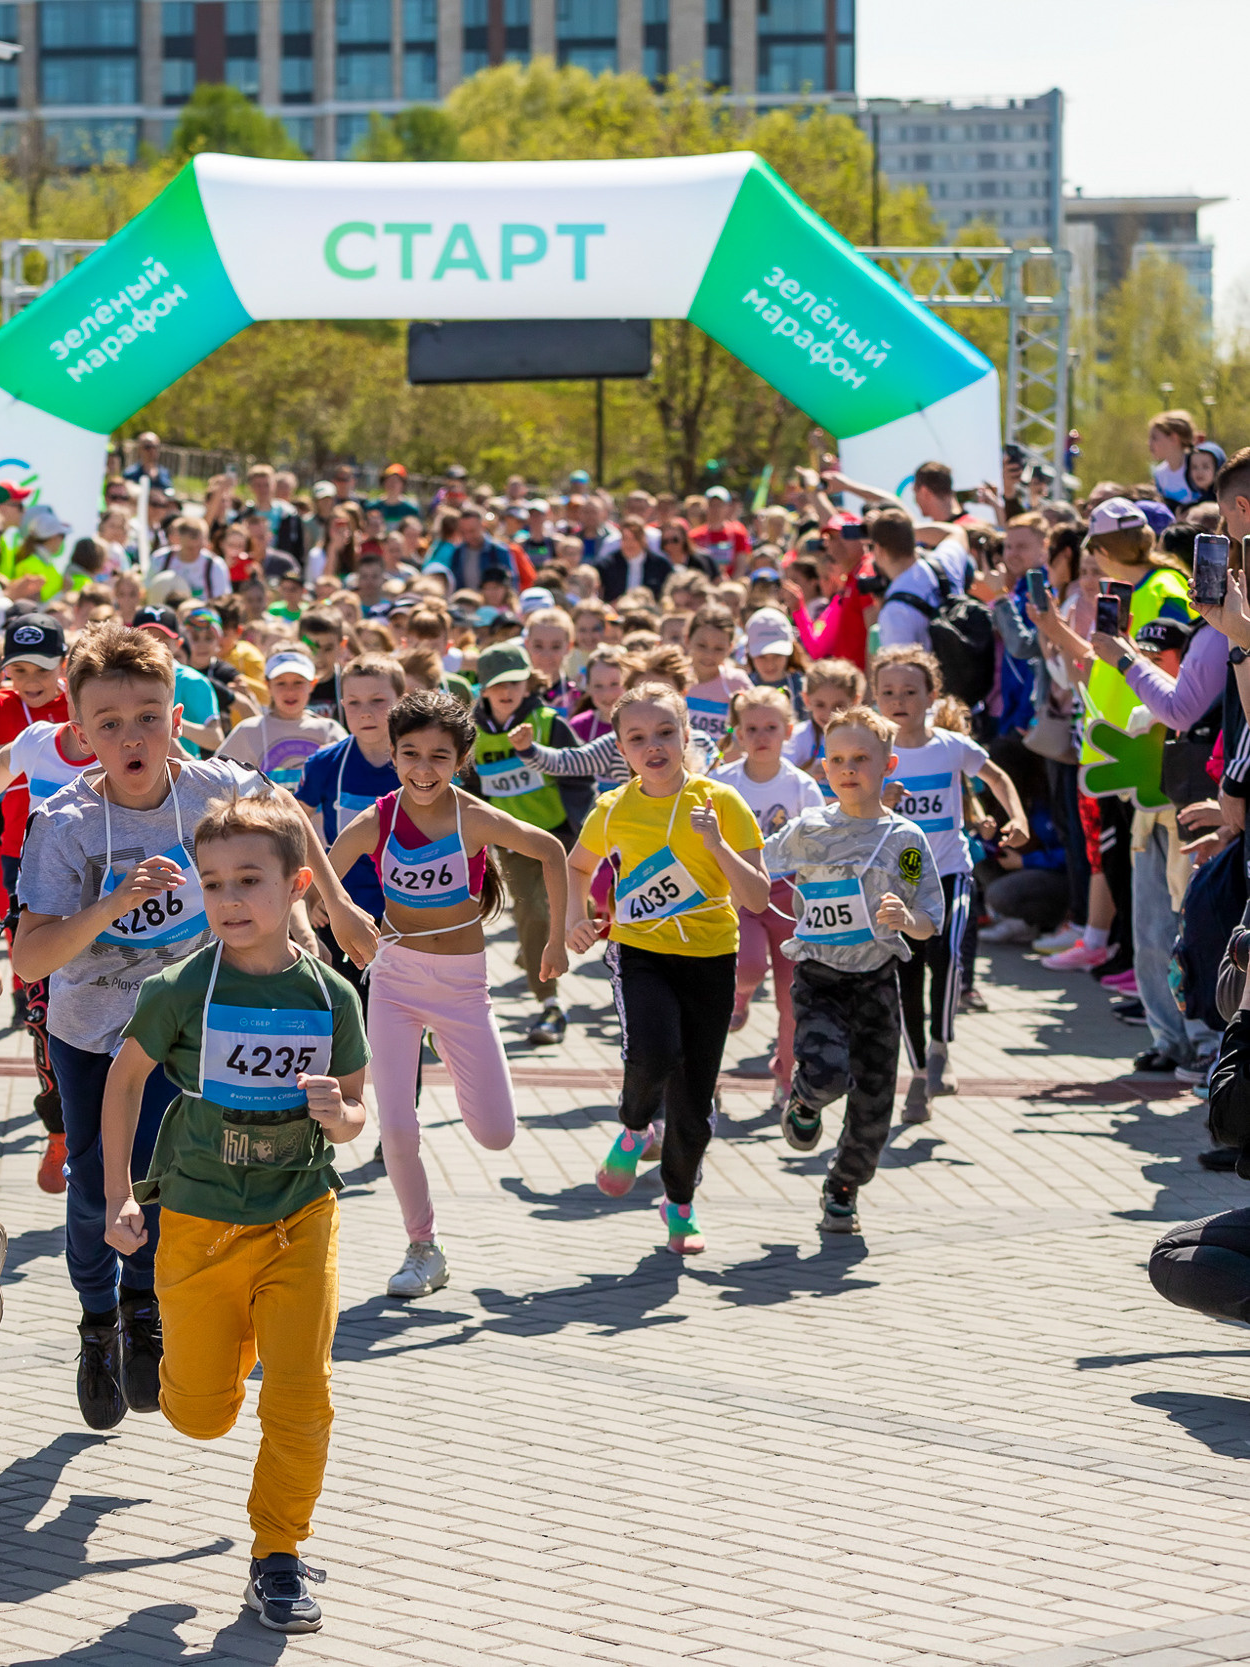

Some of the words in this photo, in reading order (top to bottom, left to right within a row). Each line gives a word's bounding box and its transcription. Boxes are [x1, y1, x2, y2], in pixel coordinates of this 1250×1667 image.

[323, 222, 606, 280] СТАРТ
[50, 257, 169, 360] зелёный
[66, 284, 188, 382] марафон
[764, 267, 892, 368] зелёный
[742, 289, 867, 389] марафон
[390, 863, 453, 890] 4296
[630, 876, 681, 919] 4035
[112, 890, 184, 936] 4286
[226, 1044, 317, 1078] 4235
